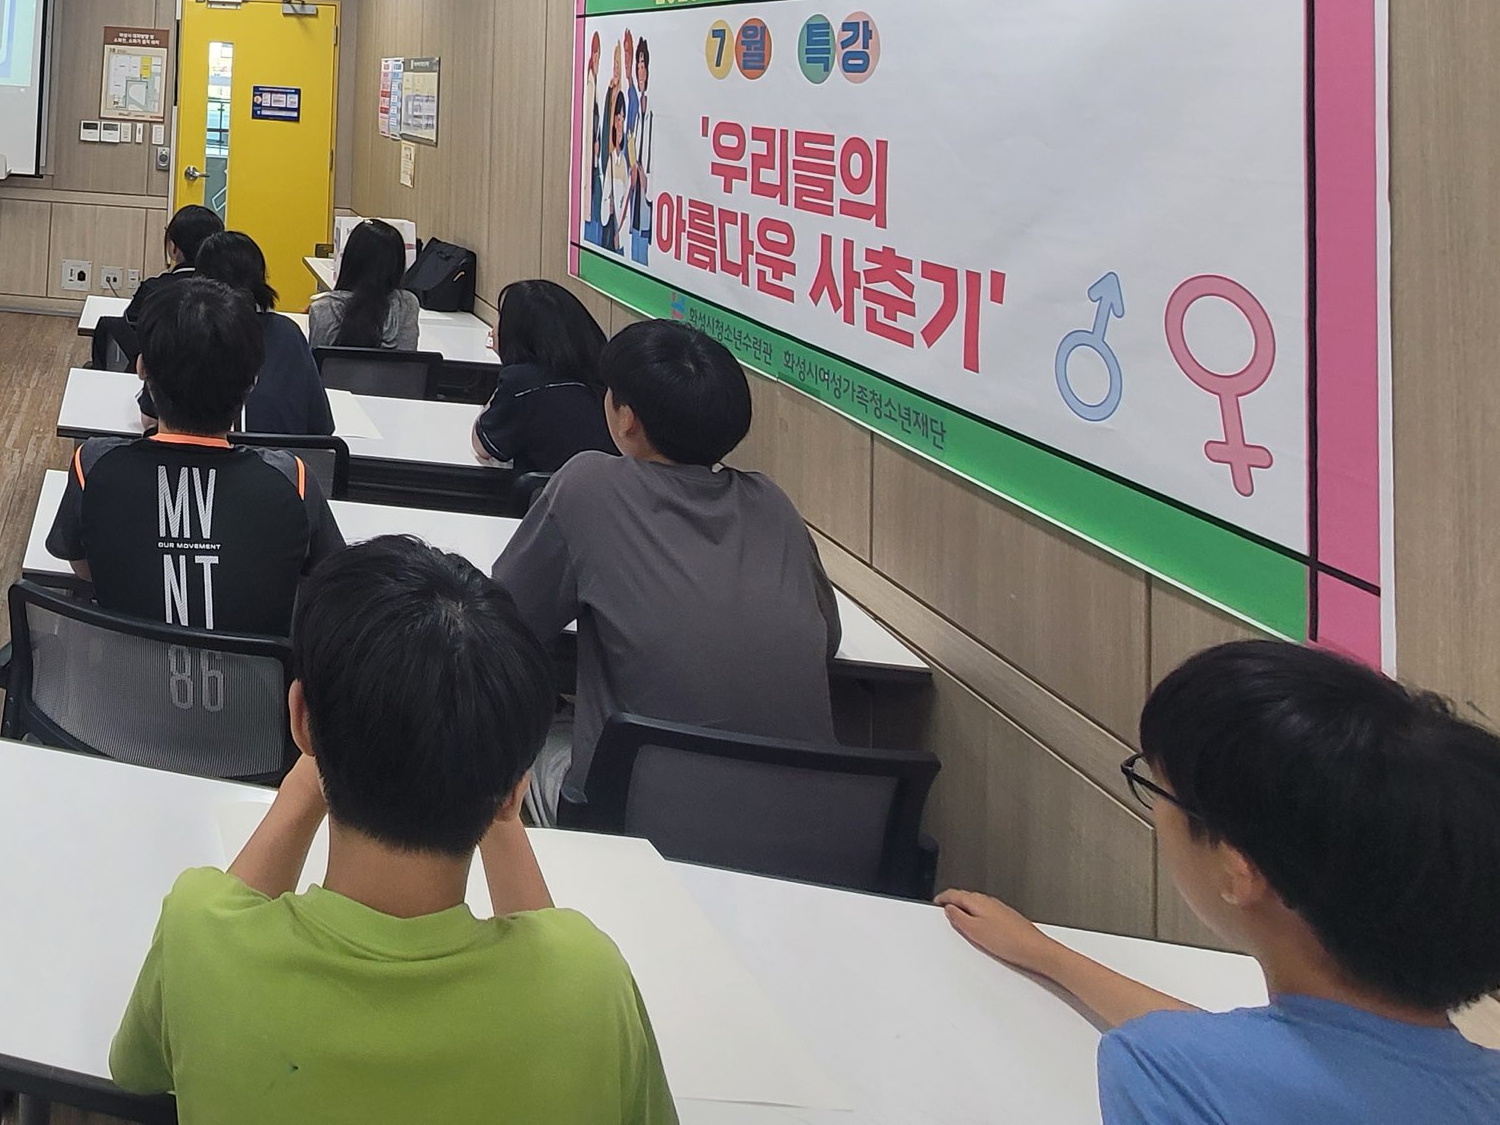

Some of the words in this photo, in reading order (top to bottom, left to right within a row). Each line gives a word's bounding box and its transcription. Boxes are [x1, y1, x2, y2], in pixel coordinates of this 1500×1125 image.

[711, 24, 766, 72] 7월
[803, 19, 874, 75] 특강
[701, 115, 889, 230] '우리들의
[655, 191, 797, 304] 아름다운
[808, 232, 1007, 374] 사춘기'
[689, 307, 774, 367] 화성시청소년수련관
[782, 349, 948, 451] 화성시여성가족청소년재단
[157, 465, 217, 539] MV
[157, 541, 175, 549] OUR
[176, 542, 221, 550] MOVEMENT
[163, 554, 220, 631] NT
[167, 643, 225, 713] 86
